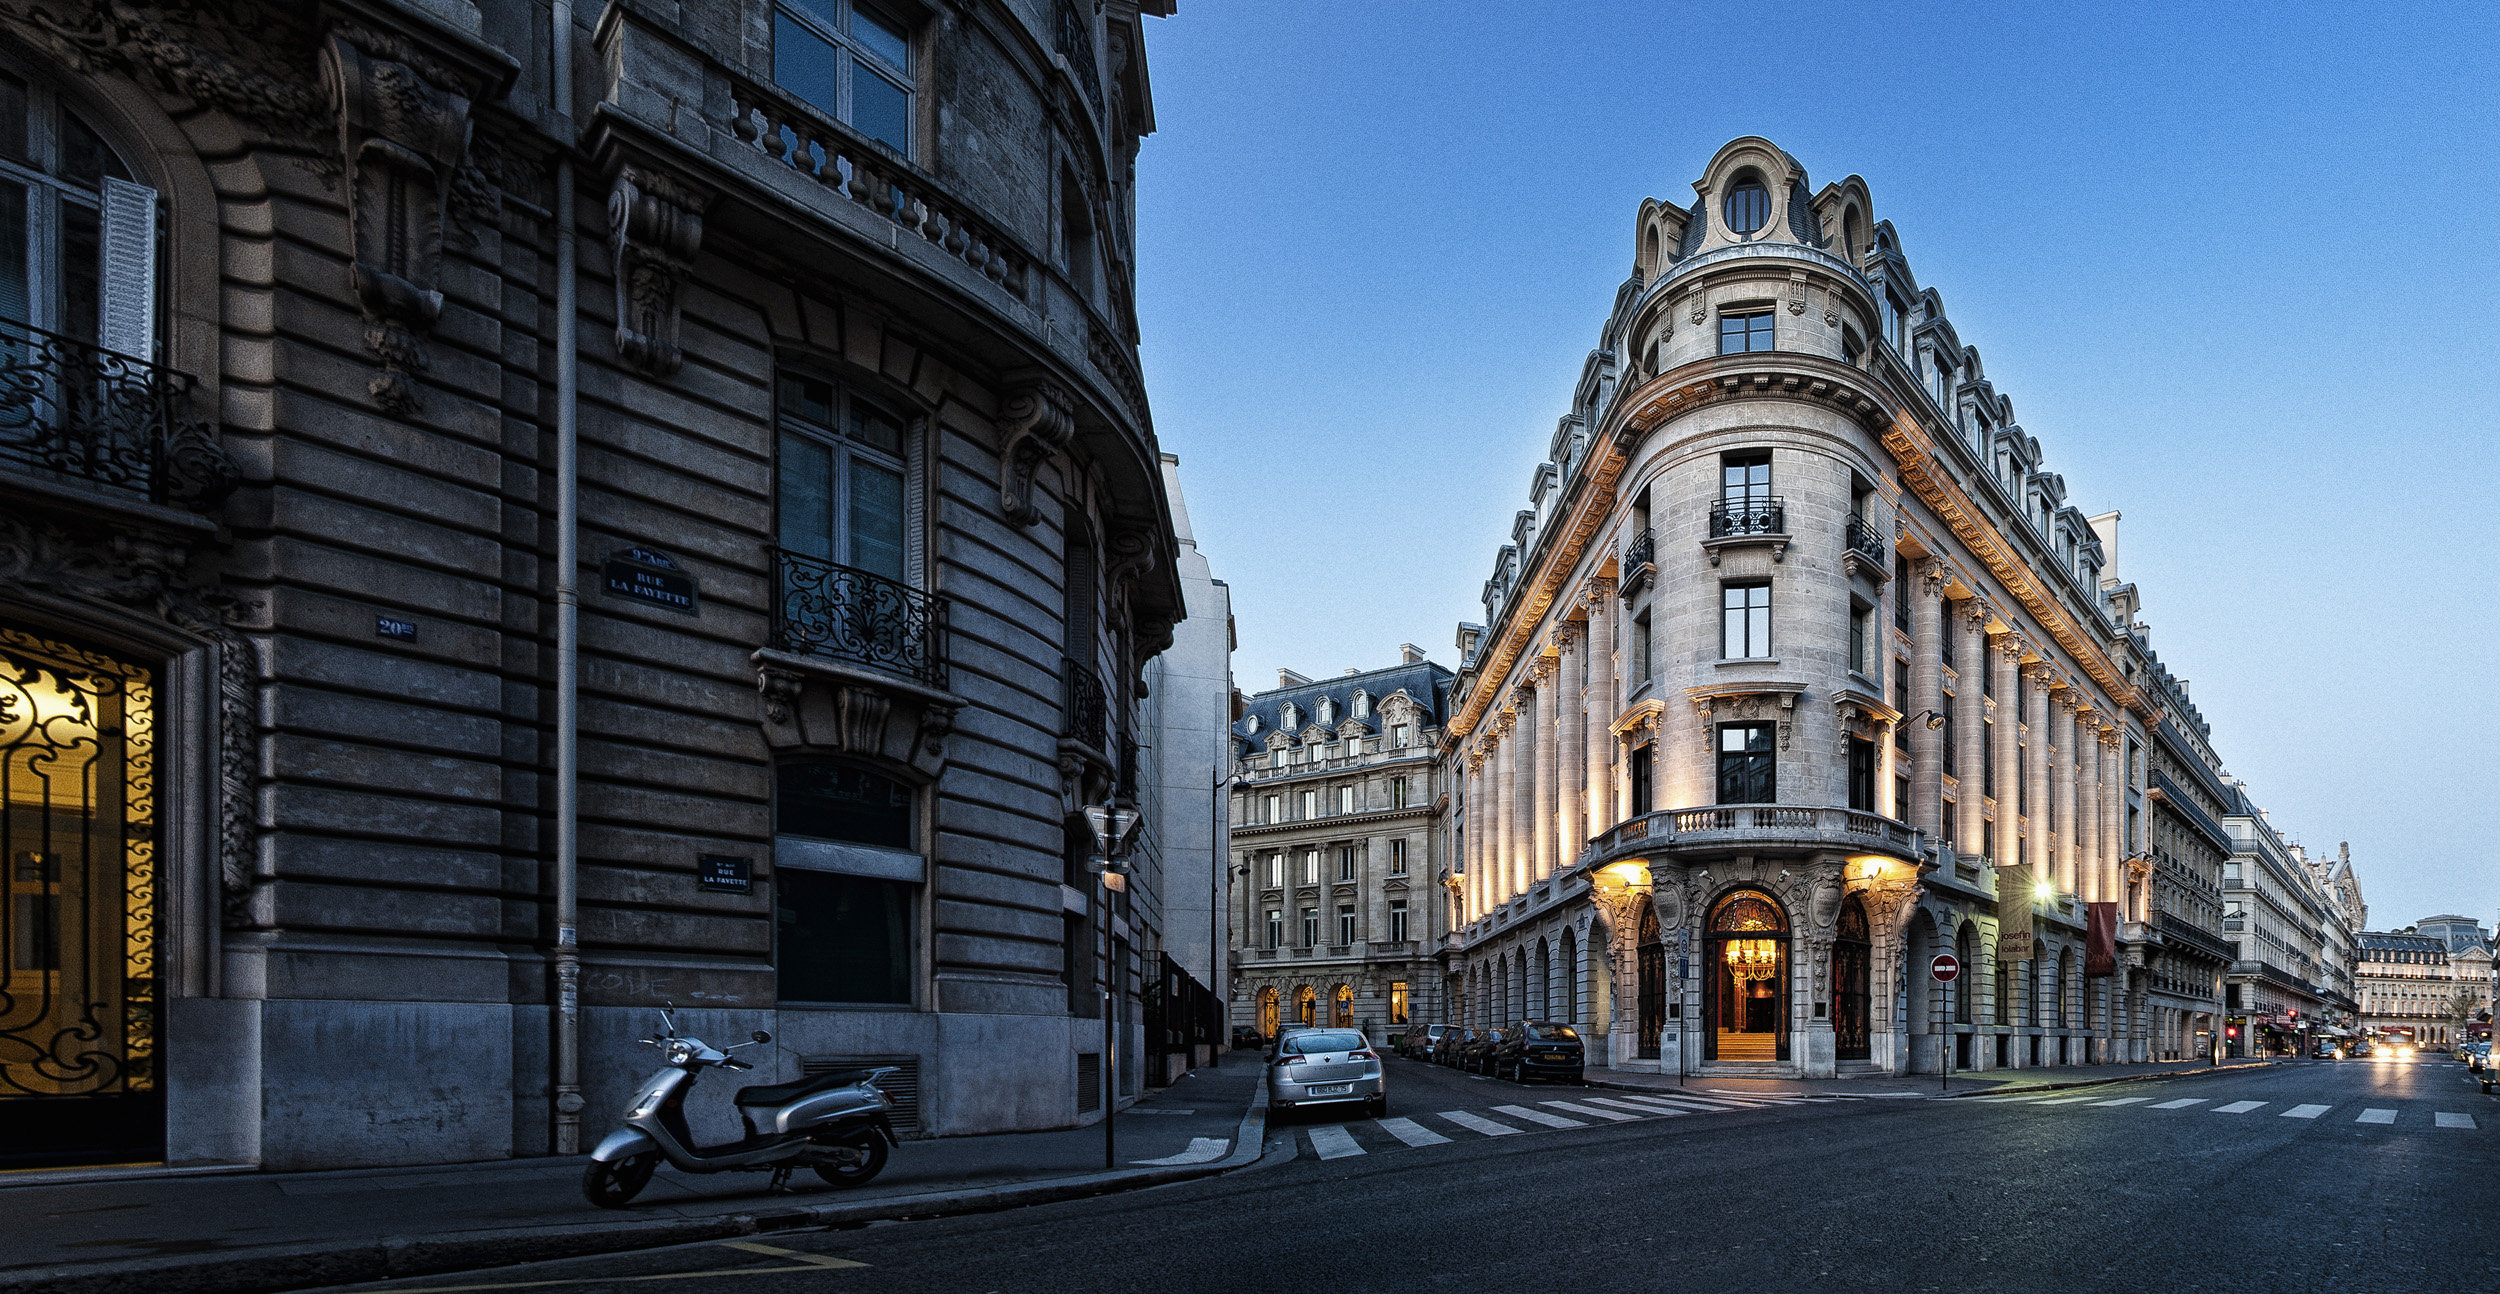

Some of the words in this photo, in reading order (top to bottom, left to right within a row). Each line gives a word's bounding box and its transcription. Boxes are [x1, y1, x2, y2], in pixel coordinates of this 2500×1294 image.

[637, 572, 664, 588] RUE
[610, 578, 629, 592] LA
[633, 584, 691, 607] FAYETTE
[717, 868, 735, 876] RUE
[703, 875, 714, 883] LA
[716, 877, 748, 886] FAYETTE
[2000, 930, 2031, 942] josefin
[2001, 944, 2030, 953] lolabar
